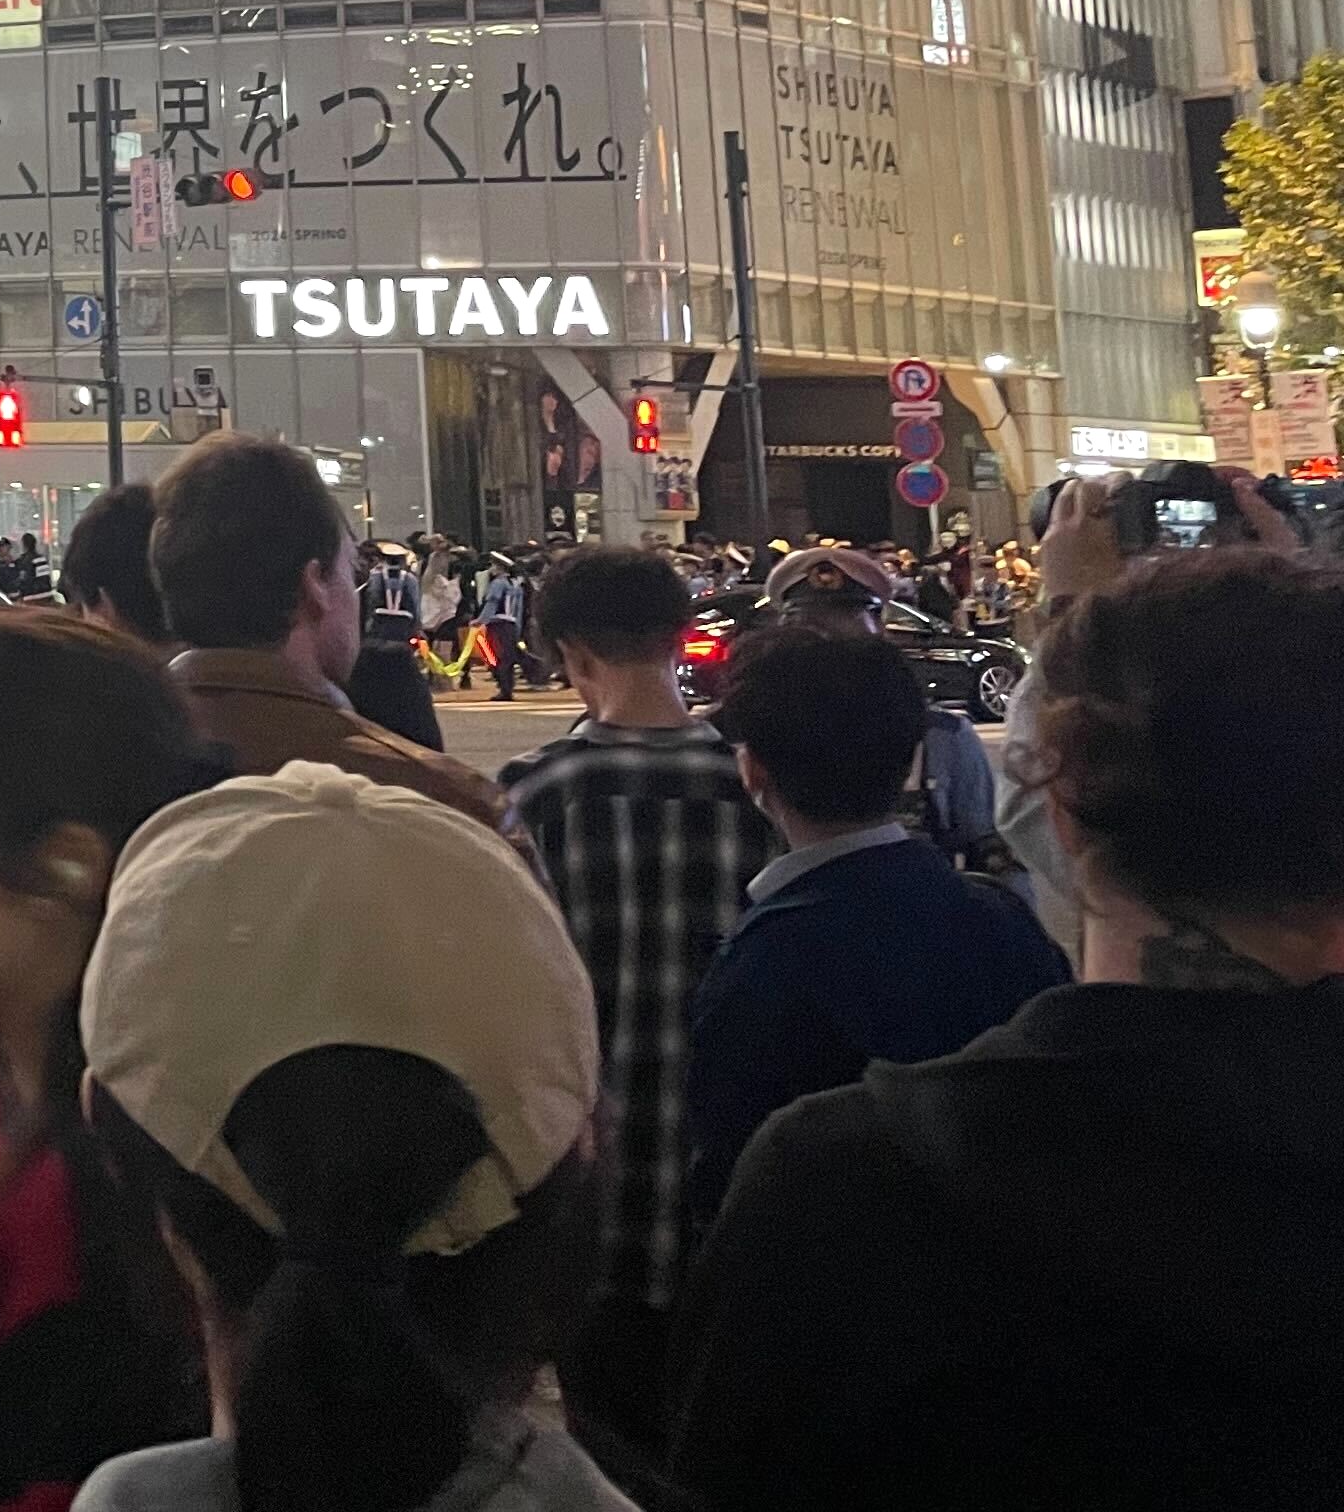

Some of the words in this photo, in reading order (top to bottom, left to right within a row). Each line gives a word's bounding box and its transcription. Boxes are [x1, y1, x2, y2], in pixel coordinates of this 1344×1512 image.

[776, 64, 895, 119] SHIBUYA
[779, 124, 900, 176] TSUTAYA
[294, 227, 347, 240] SPRING
[782, 184, 910, 235] RENEWAL
[239, 276, 610, 339] TSUTAYA
[768, 445, 857, 457] TARBUCKS
